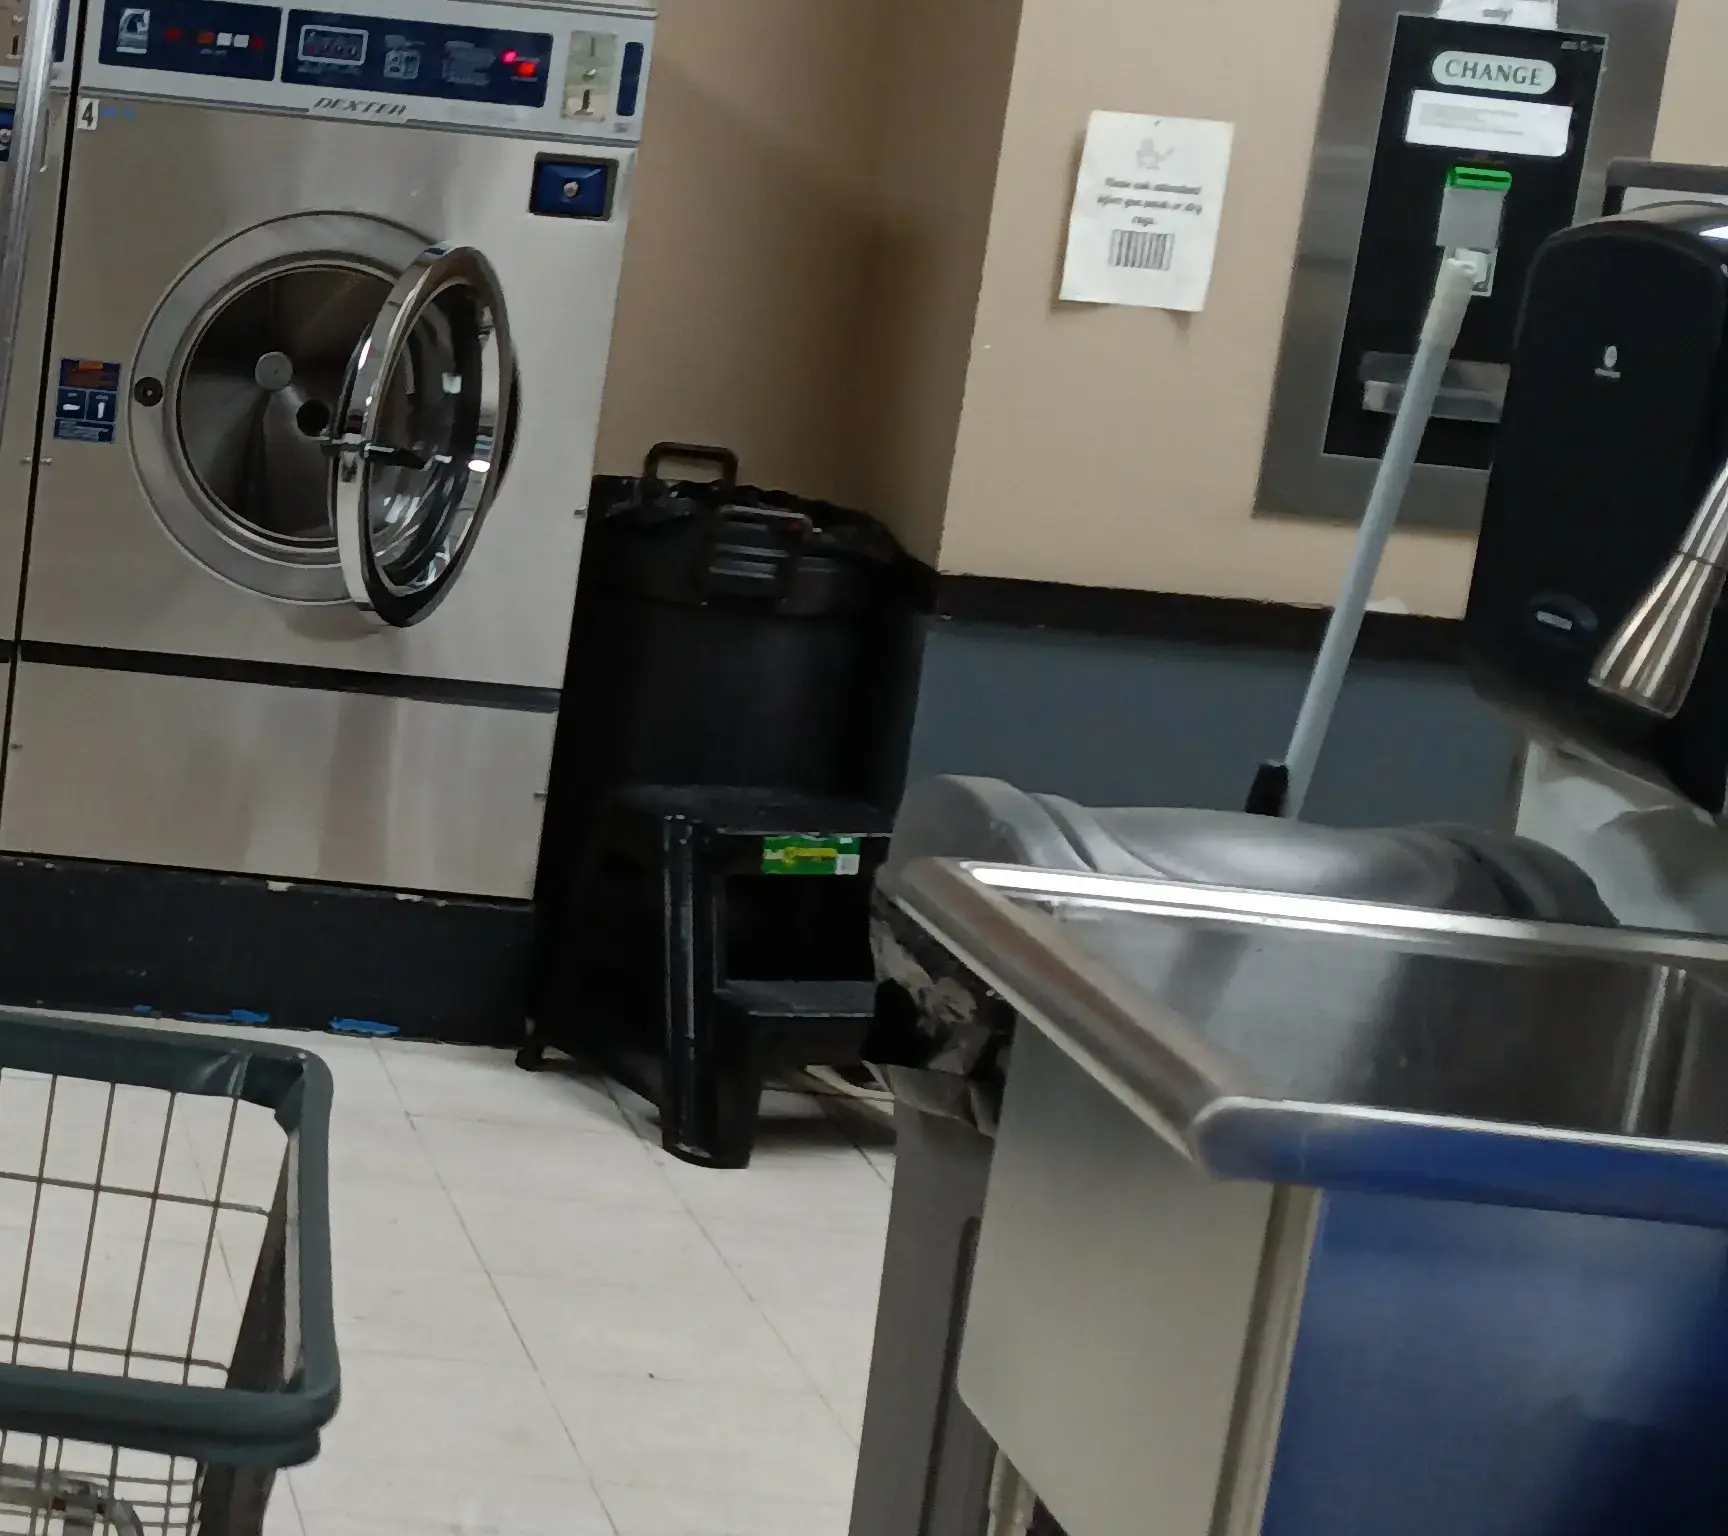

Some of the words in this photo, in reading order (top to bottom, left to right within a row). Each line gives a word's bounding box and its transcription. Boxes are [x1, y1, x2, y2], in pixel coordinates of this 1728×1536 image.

[1445, 58, 1543, 87] CHANGE
[81, 101, 94, 128] 4
[312, 96, 408, 116] DEXTER
